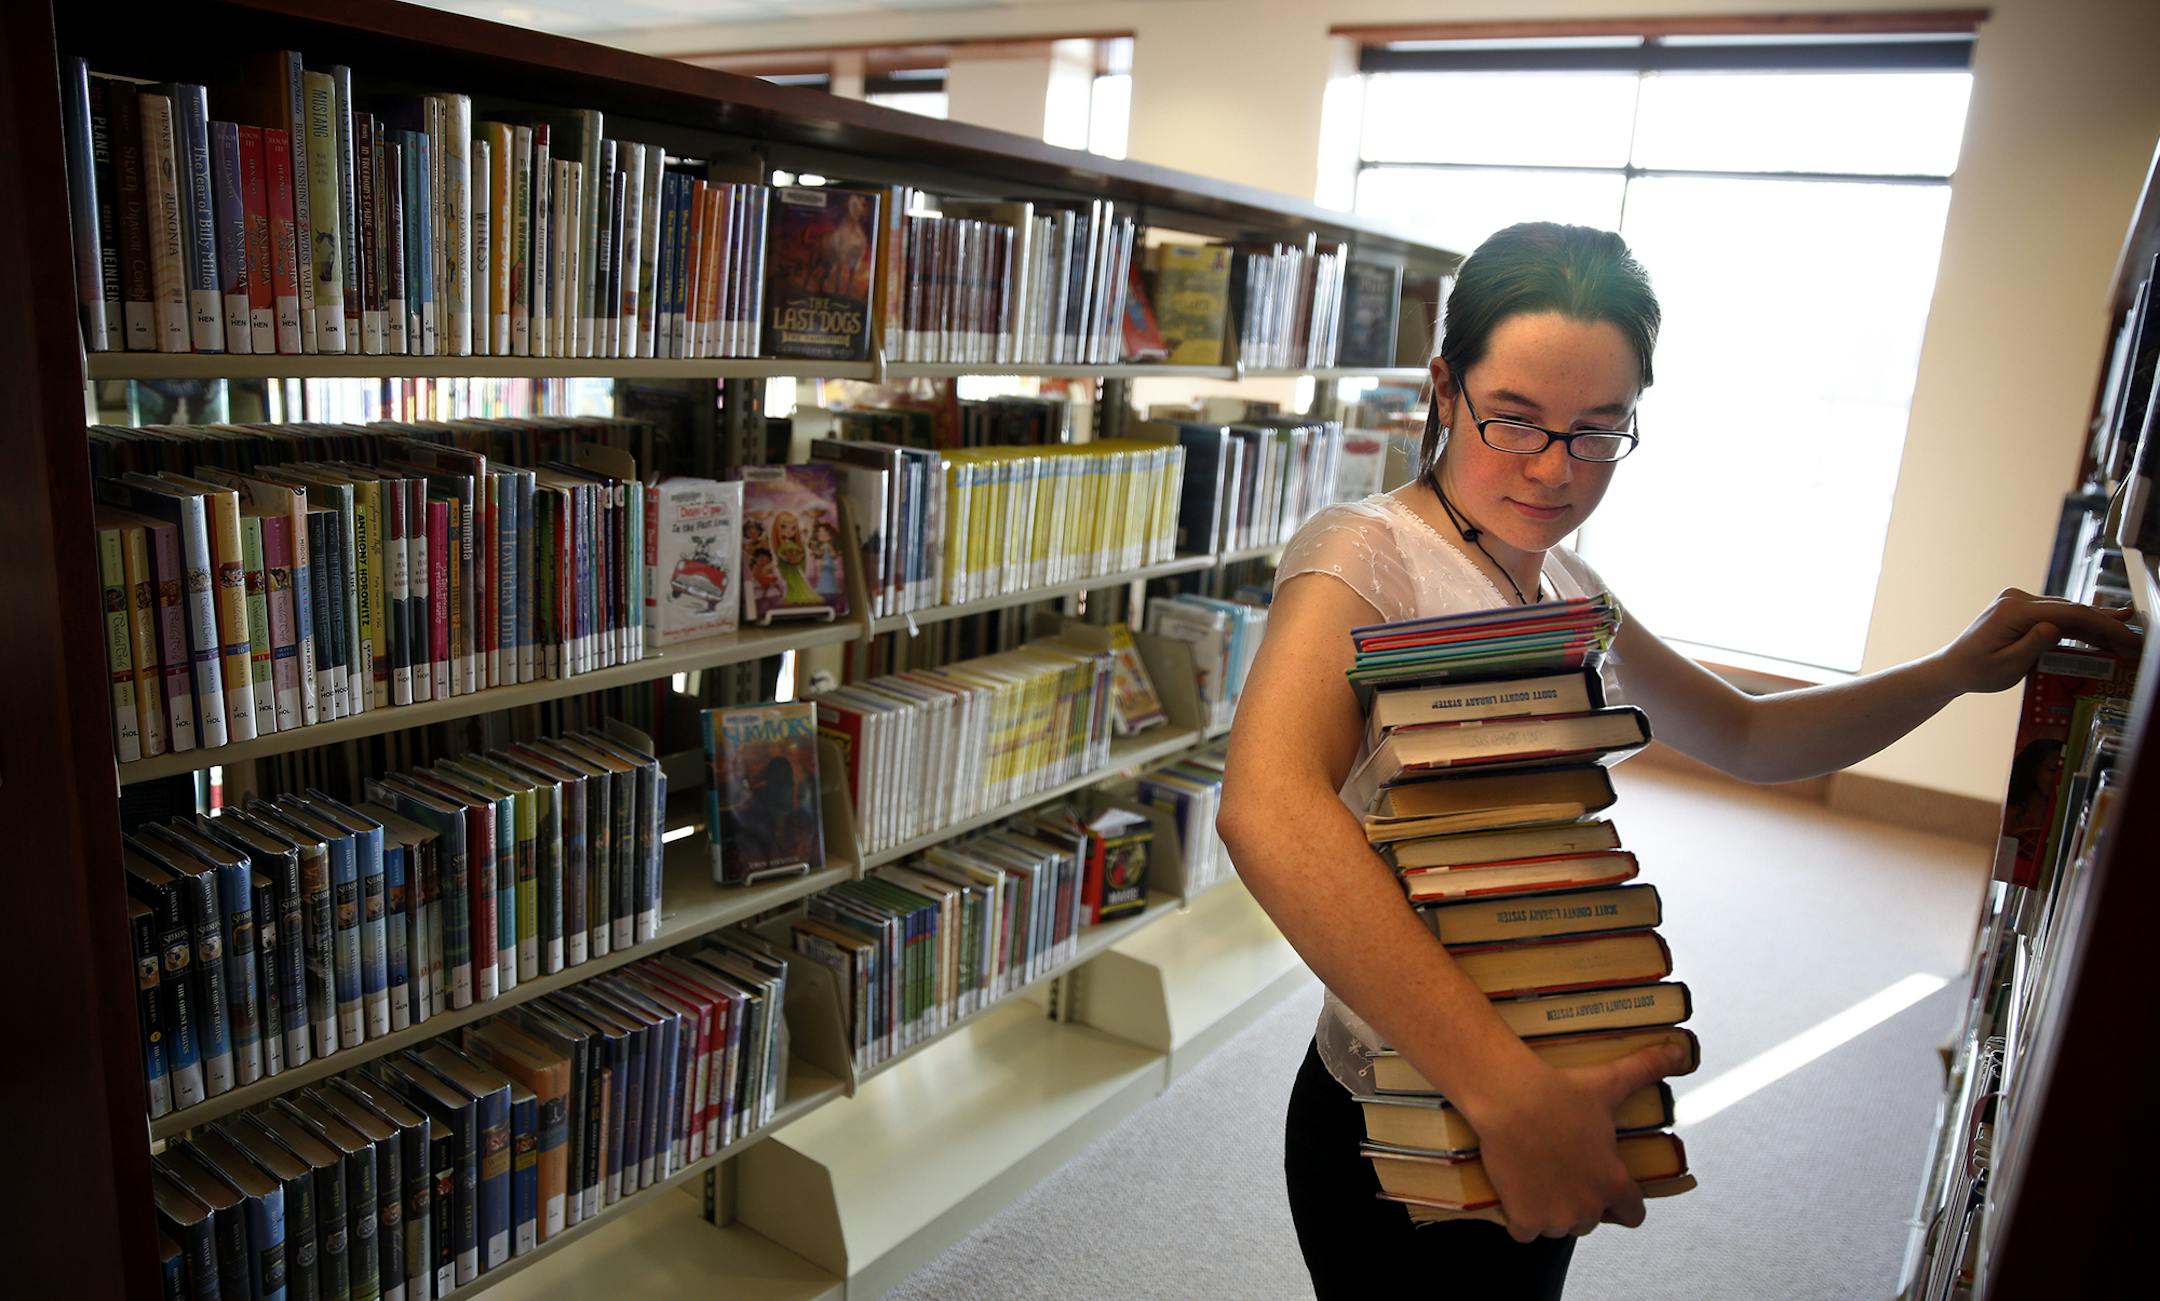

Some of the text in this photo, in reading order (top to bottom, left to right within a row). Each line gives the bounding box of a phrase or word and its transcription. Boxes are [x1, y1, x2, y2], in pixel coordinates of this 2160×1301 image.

[311, 89, 329, 138] MUSTANG
[94, 116, 110, 164] PLANET
[166, 193, 179, 256] JUNONIA
[194, 145, 216, 290] The Year of Billy Miller
[295, 123, 313, 301] BROWN SUNSHINE OF SAWDUST VALLEY
[103, 248, 119, 303] HEINLEIN
[772, 307, 862, 335] LAST DOGS
[462, 503, 474, 560] Bunnicula
[672, 523, 681, 533] In
[683, 523, 695, 532] the
[358, 514, 371, 626] ANTHONY HOROWITZ
[500, 528, 516, 643] Howliday Inn
[234, 711, 248, 719] HOL
[1466, 695, 1497, 706] LIBRARY
[1500, 692, 1530, 703] COUNTY
[1533, 689, 1558, 700] SCOTT
[122, 730, 138, 738] HOL
[1547, 994, 1655, 1021] SCOTT COUNTY LIBRARY SYSTEM
